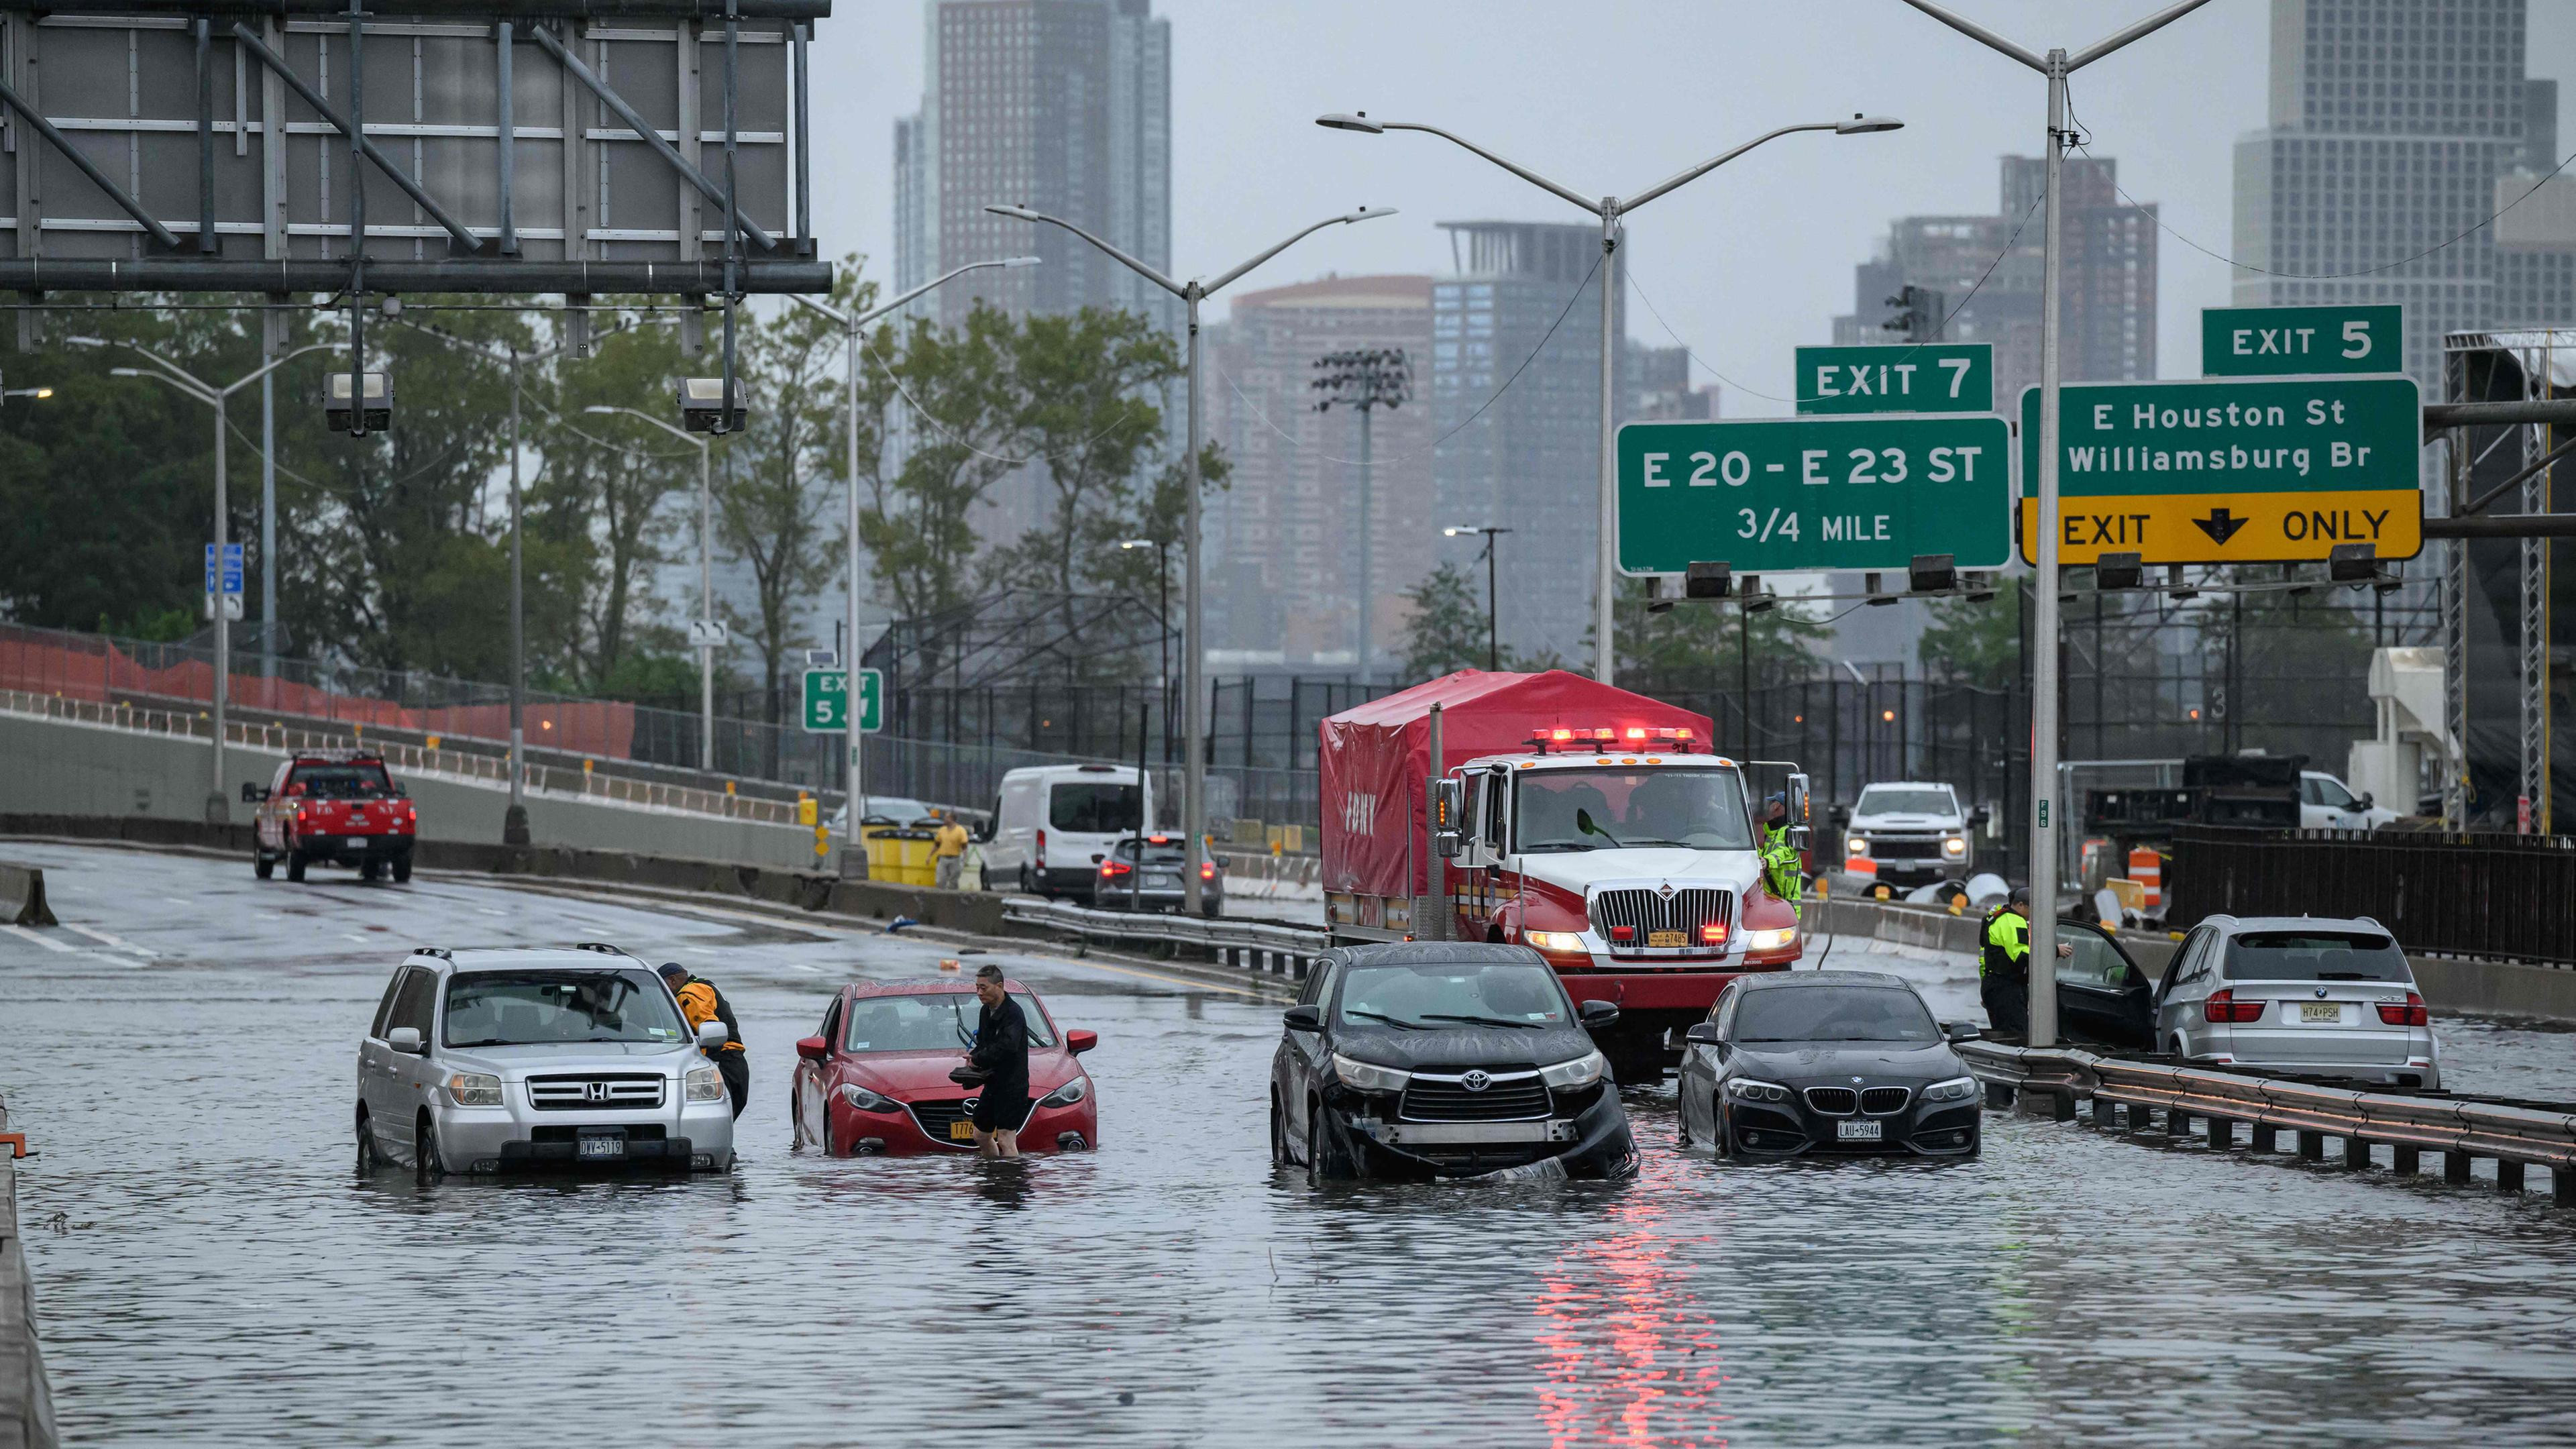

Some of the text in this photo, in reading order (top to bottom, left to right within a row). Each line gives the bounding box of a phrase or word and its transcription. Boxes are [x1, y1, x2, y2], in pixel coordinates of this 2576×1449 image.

[2234, 321, 2372, 359] EXIT 5
[1817, 358, 1971, 398] EXIT 7
[2094, 399, 2345, 430] E Houston St
[1644, 452, 1670, 488] E
[1688, 450, 1750, 486] 20
[1802, 449, 1829, 485] E
[1848, 447, 1908, 484] 23
[1927, 446, 1982, 483] ST
[2069, 442, 2371, 476] Williamsburg Br
[1737, 507, 1891, 543] 3/4 MILE
[2064, 510, 2390, 545] EXIT ONLY
[820, 676, 869, 692] EXT
[816, 700, 833, 723] 5
[1346, 791, 1376, 835] FDNY
[1670, 933, 1686, 943] 7485
